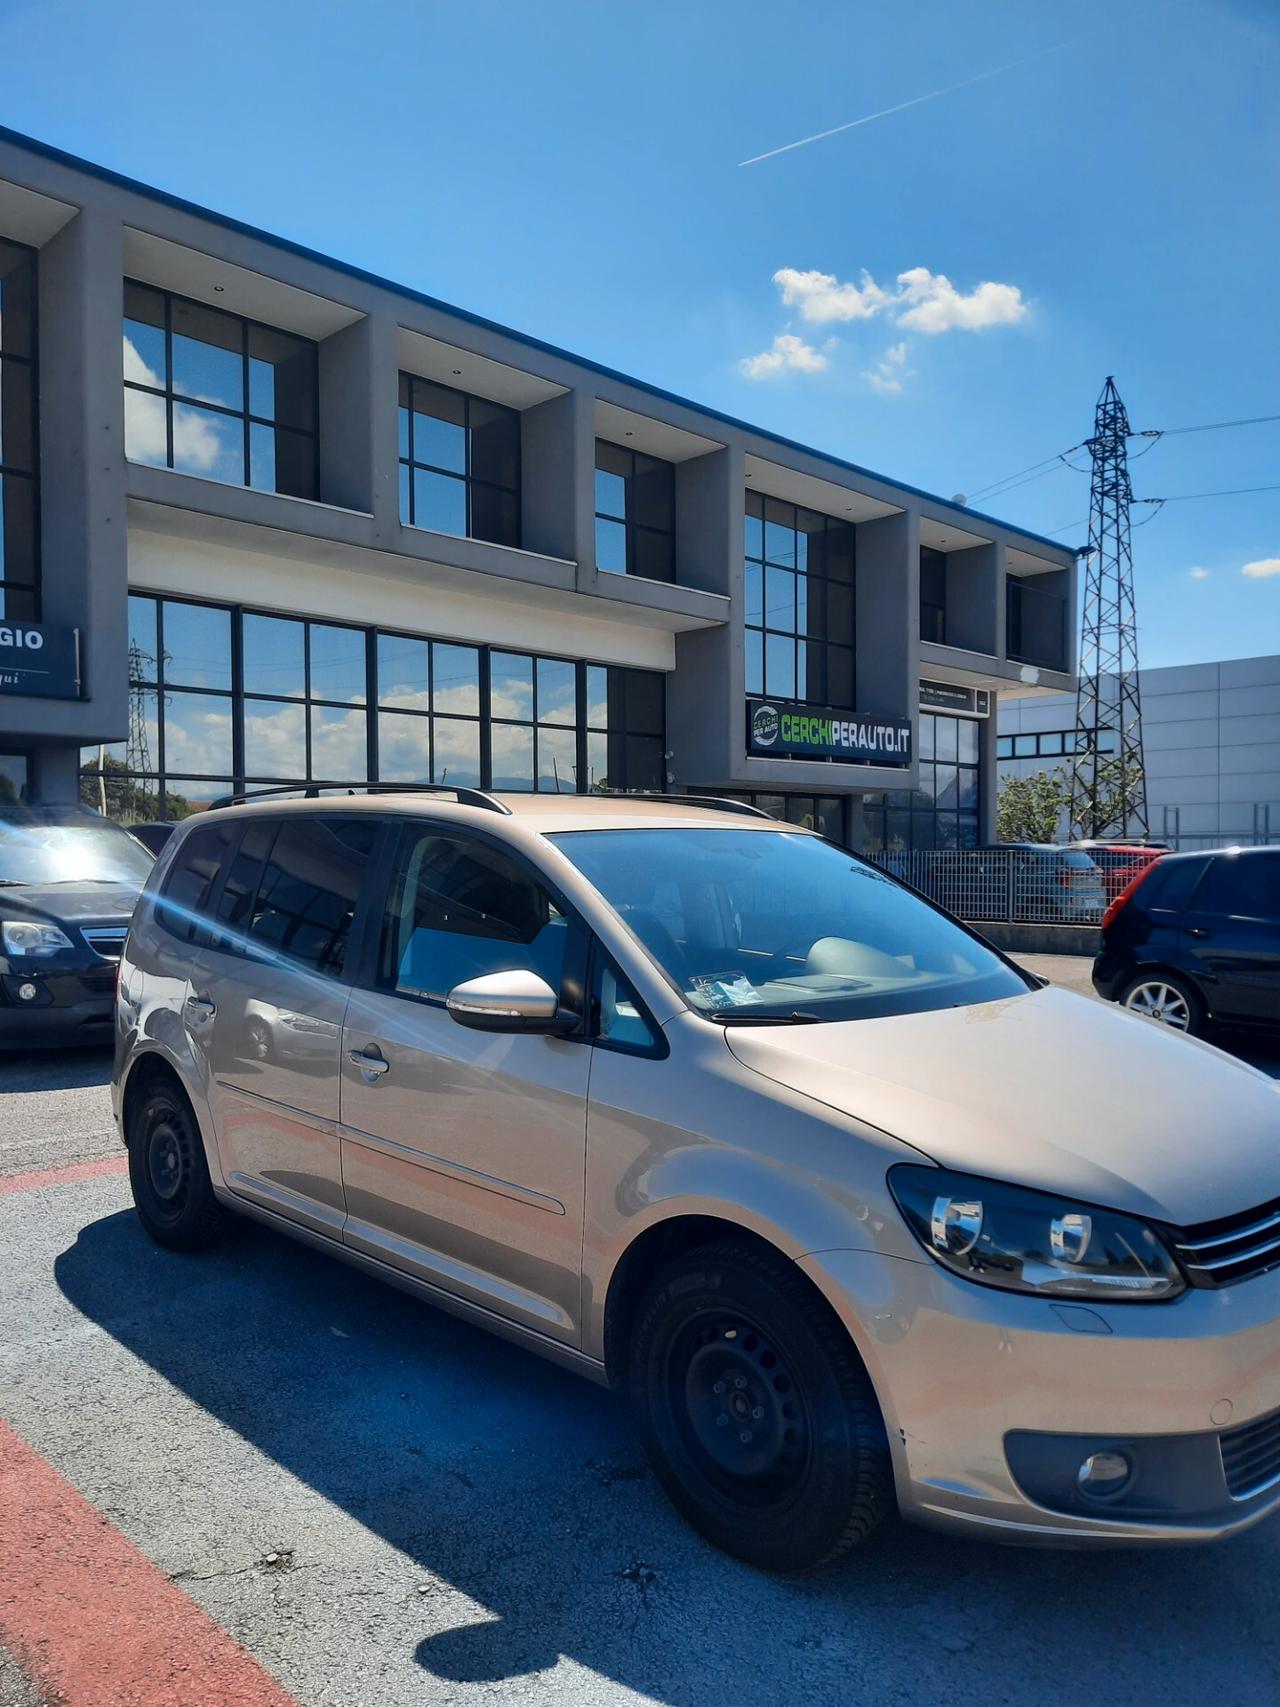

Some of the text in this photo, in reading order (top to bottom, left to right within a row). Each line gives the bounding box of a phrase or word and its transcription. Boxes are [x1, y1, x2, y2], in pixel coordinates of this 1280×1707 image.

[0, 627, 43, 650] GIO
[753, 715, 779, 730] CERCHI
[753, 722, 779, 737] PER AUTO
